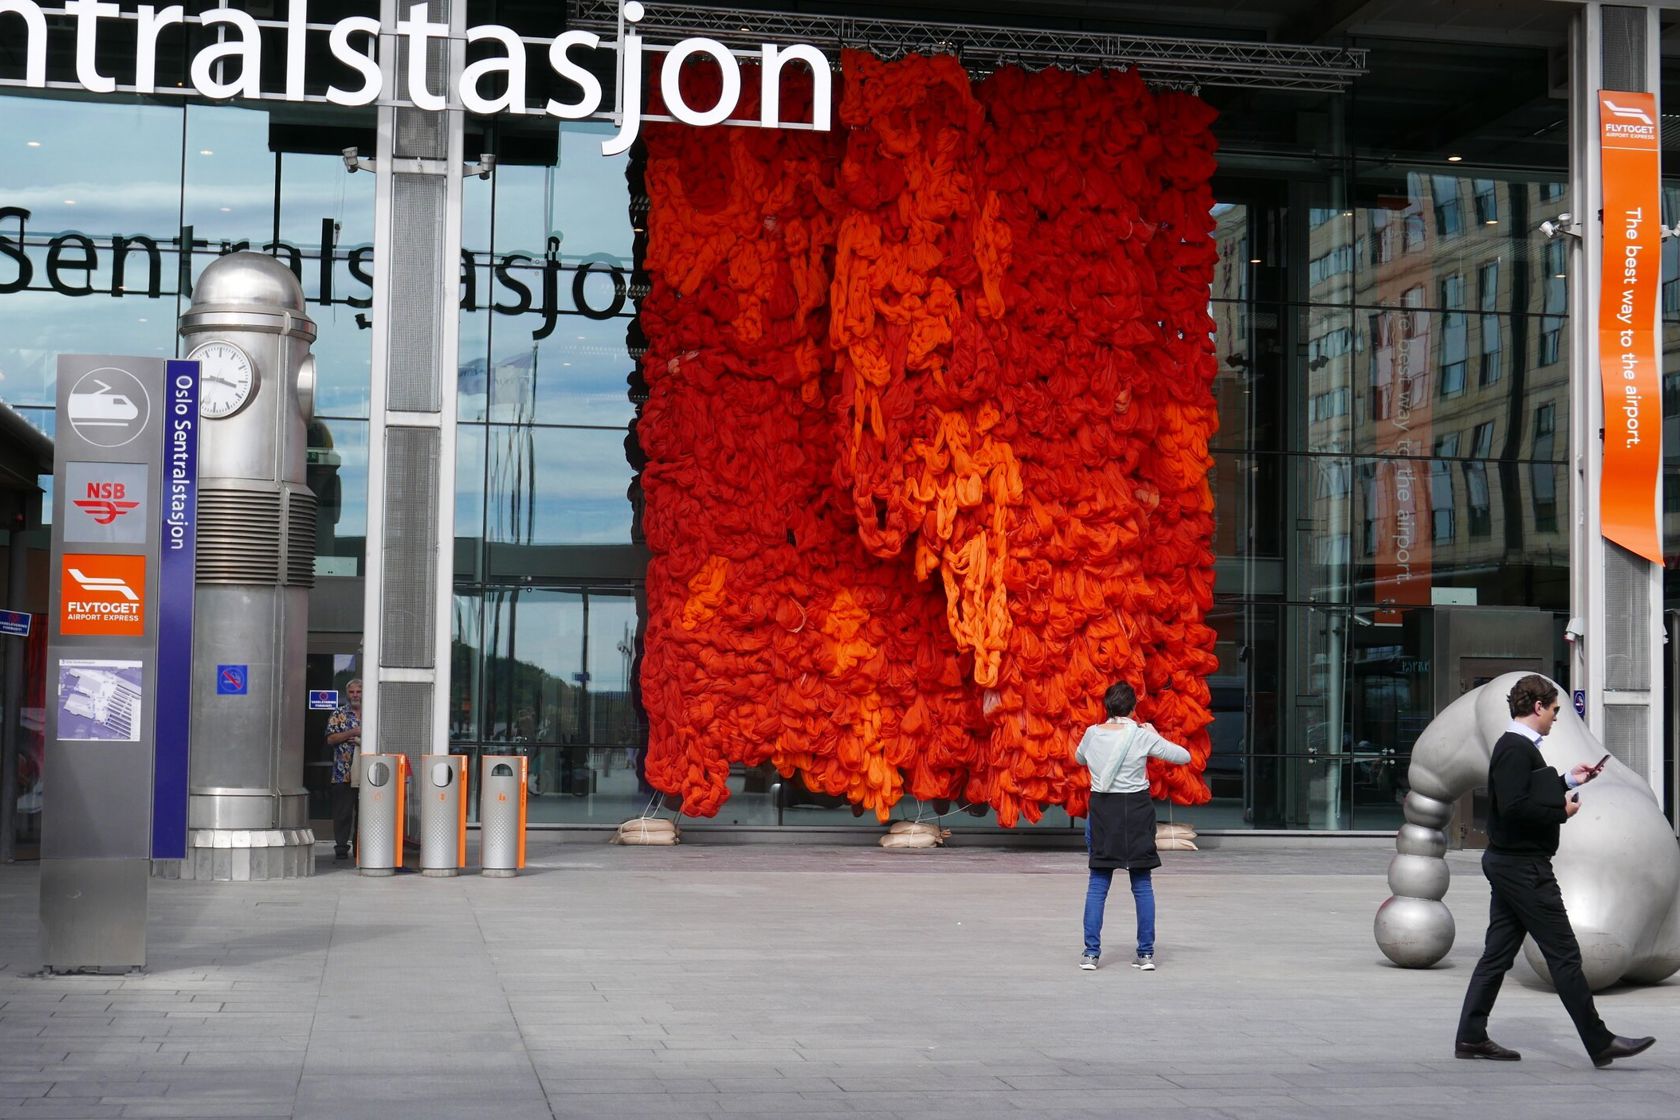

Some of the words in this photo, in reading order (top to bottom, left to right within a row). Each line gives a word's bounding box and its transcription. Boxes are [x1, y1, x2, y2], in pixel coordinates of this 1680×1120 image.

[1605, 123, 1655, 134] FLYTOGET
[1625, 207, 1642, 240] The
[1624, 246, 1643, 284] best
[1617, 290, 1634, 324] way
[1620, 329, 1634, 348] to
[1399, 340, 1413, 385] best
[1621, 355, 1639, 380] the
[174, 375, 193, 415] Oslo
[1393, 391, 1411, 432] way
[1623, 386, 1642, 449] airport.
[87, 482, 125, 499] NSB
[166, 420, 192, 549] Sentralstasjon
[1397, 469, 1416, 502] the
[1392, 509, 1415, 585] airport.
[67, 601, 140, 614] FLYTOGET
[103, 614, 139, 622] EXPRESS
